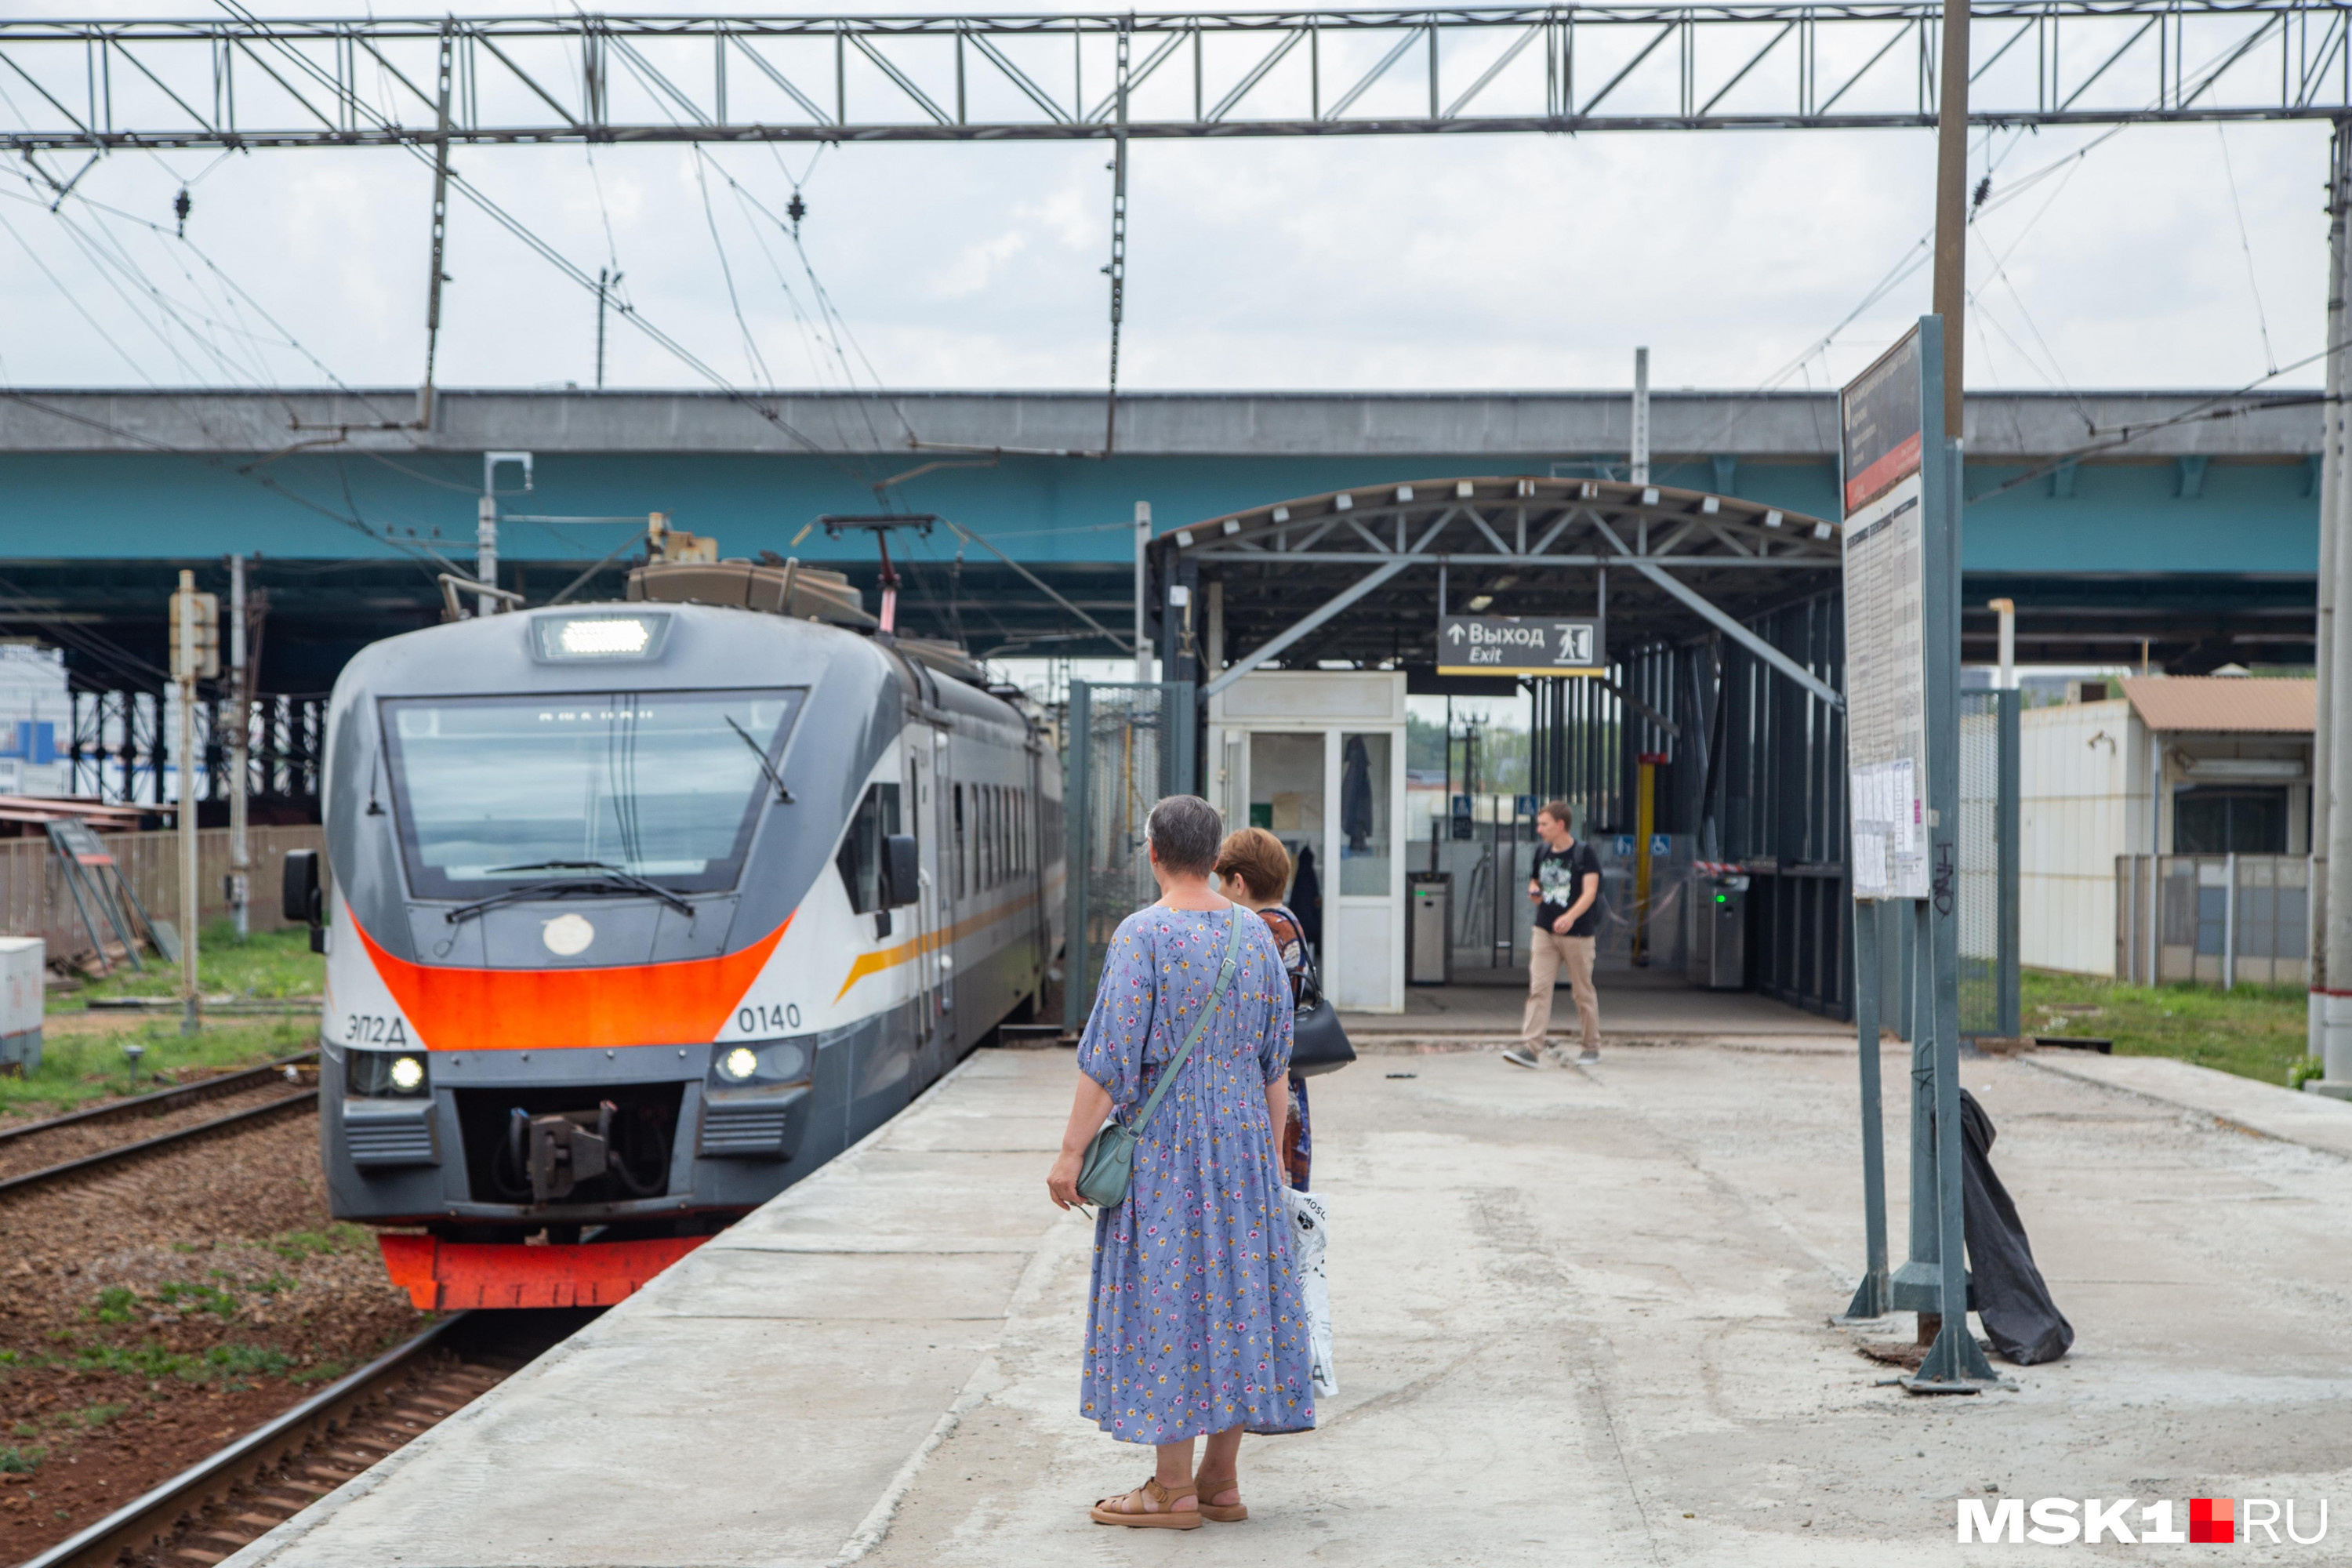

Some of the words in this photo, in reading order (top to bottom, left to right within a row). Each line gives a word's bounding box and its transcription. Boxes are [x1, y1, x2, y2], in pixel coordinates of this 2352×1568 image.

[1468, 622, 1544, 648] Выход
[1468, 647, 1503, 663] Exit
[345, 1014, 406, 1046] ЭП2Д
[739, 1004, 800, 1033] 0140
